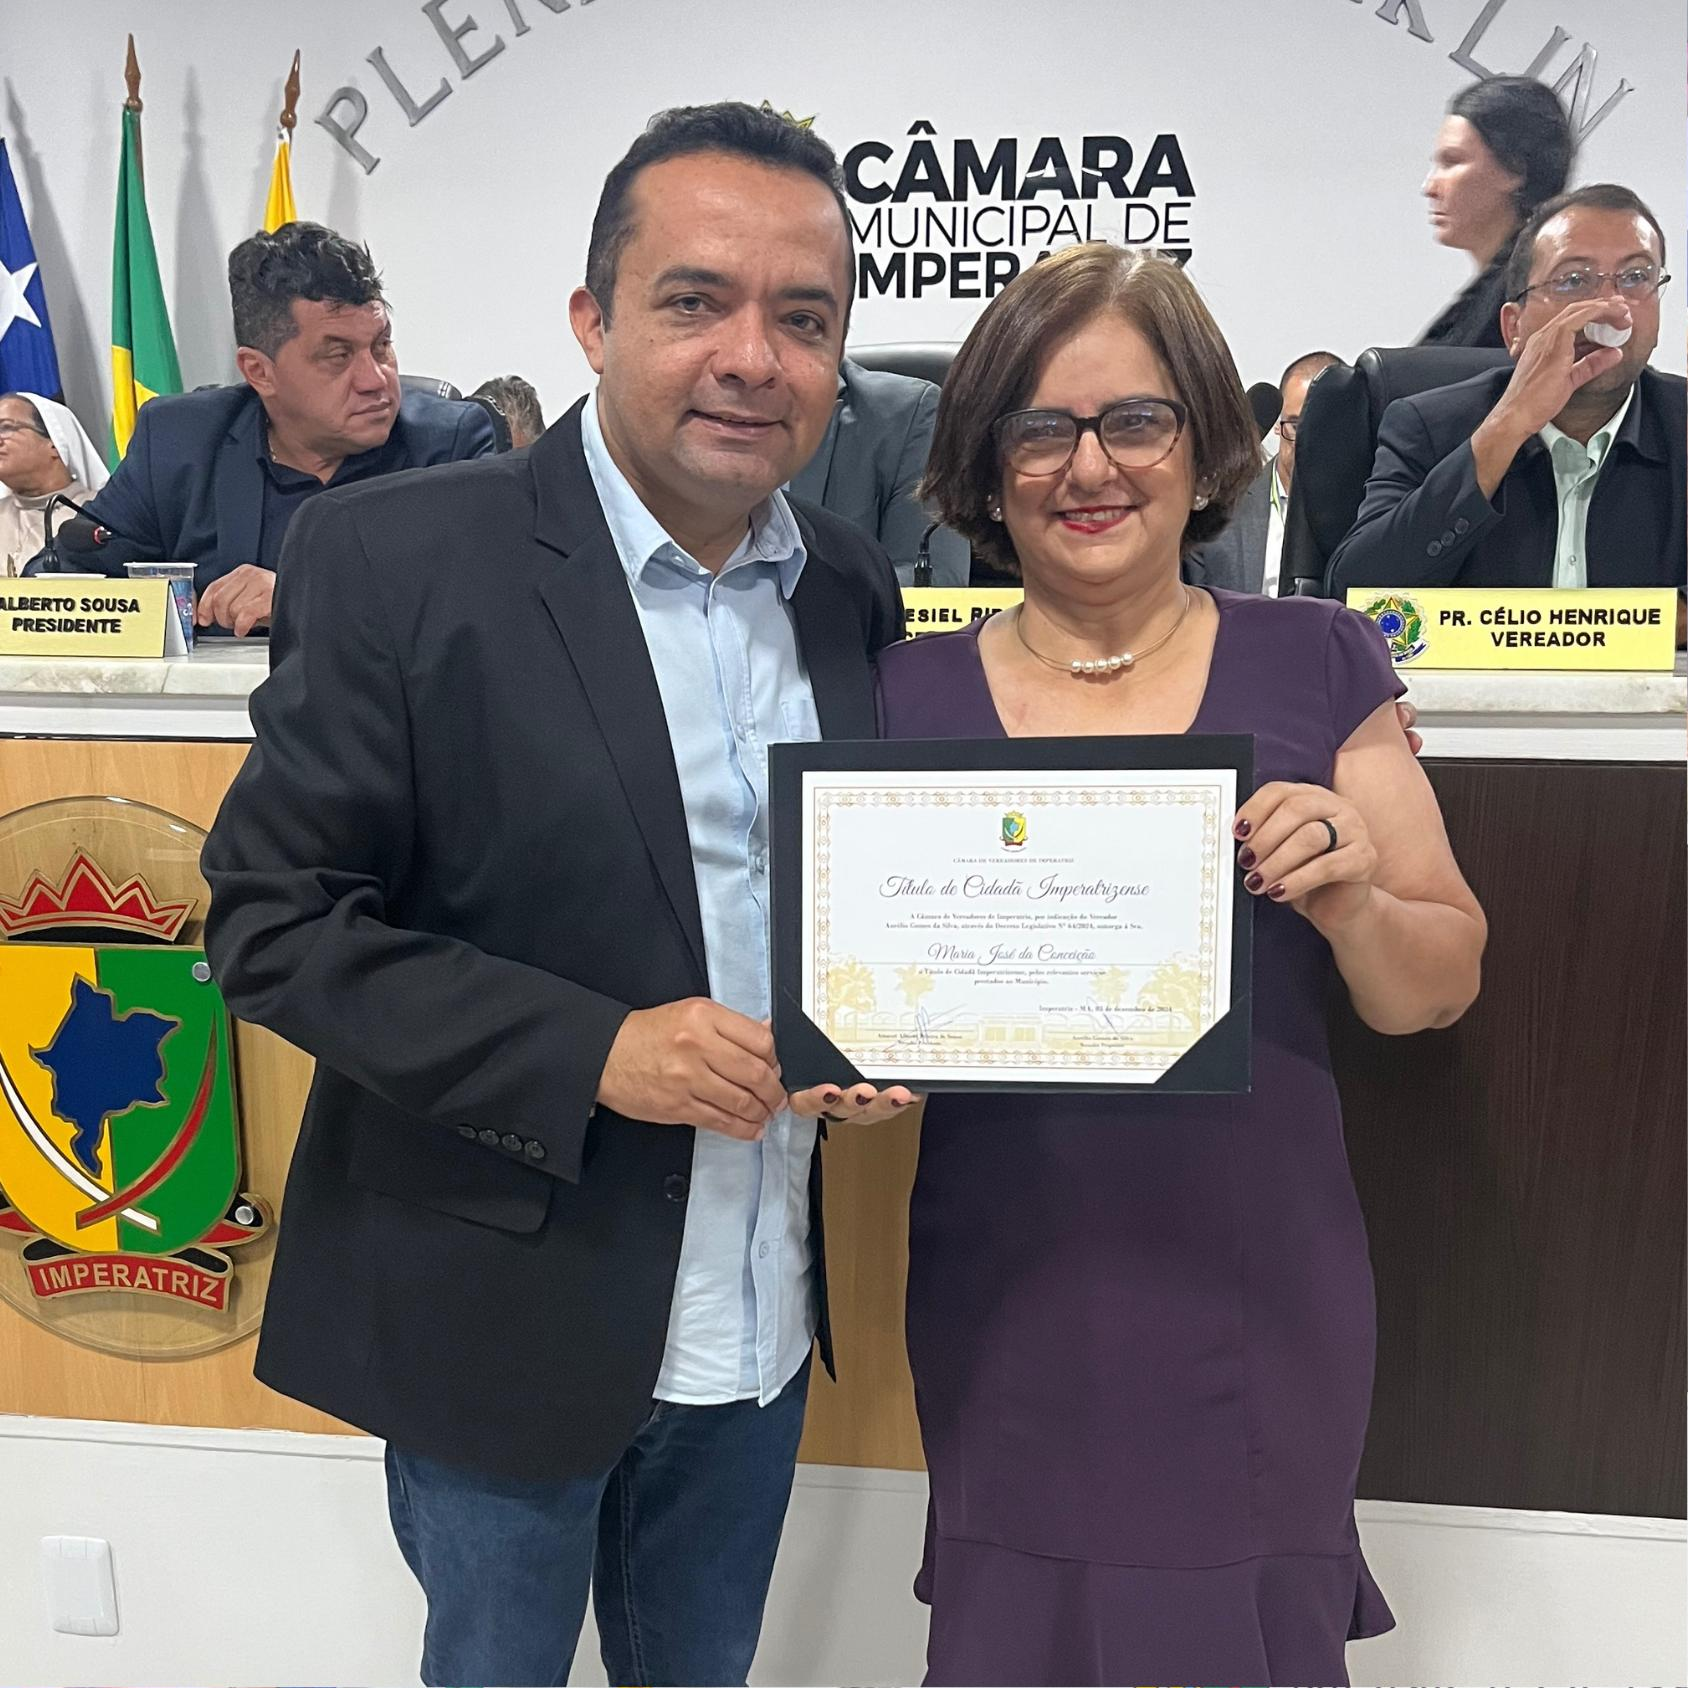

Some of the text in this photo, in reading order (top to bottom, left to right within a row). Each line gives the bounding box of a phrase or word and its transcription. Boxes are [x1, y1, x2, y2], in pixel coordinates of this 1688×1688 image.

[843, 120, 1196, 204] CÂMARA
[848, 203, 1192, 248] MUNICIPAL DE
[0, 597, 140, 613] ALBERTO SOUSA
[905, 608, 962, 622] ESIEL
[12, 618, 122, 633] PRESIDENTE
[1440, 607, 1661, 626] PR. CÉLIO HENRIQUE
[1491, 631, 1606, 647] VEREADOR
[879, 873, 1150, 903] Título de Cidadã Imperatrizense
[928, 943, 1096, 966] Maria José da Conceição
[39, 1263, 220, 1302] IMPERATRIZ
